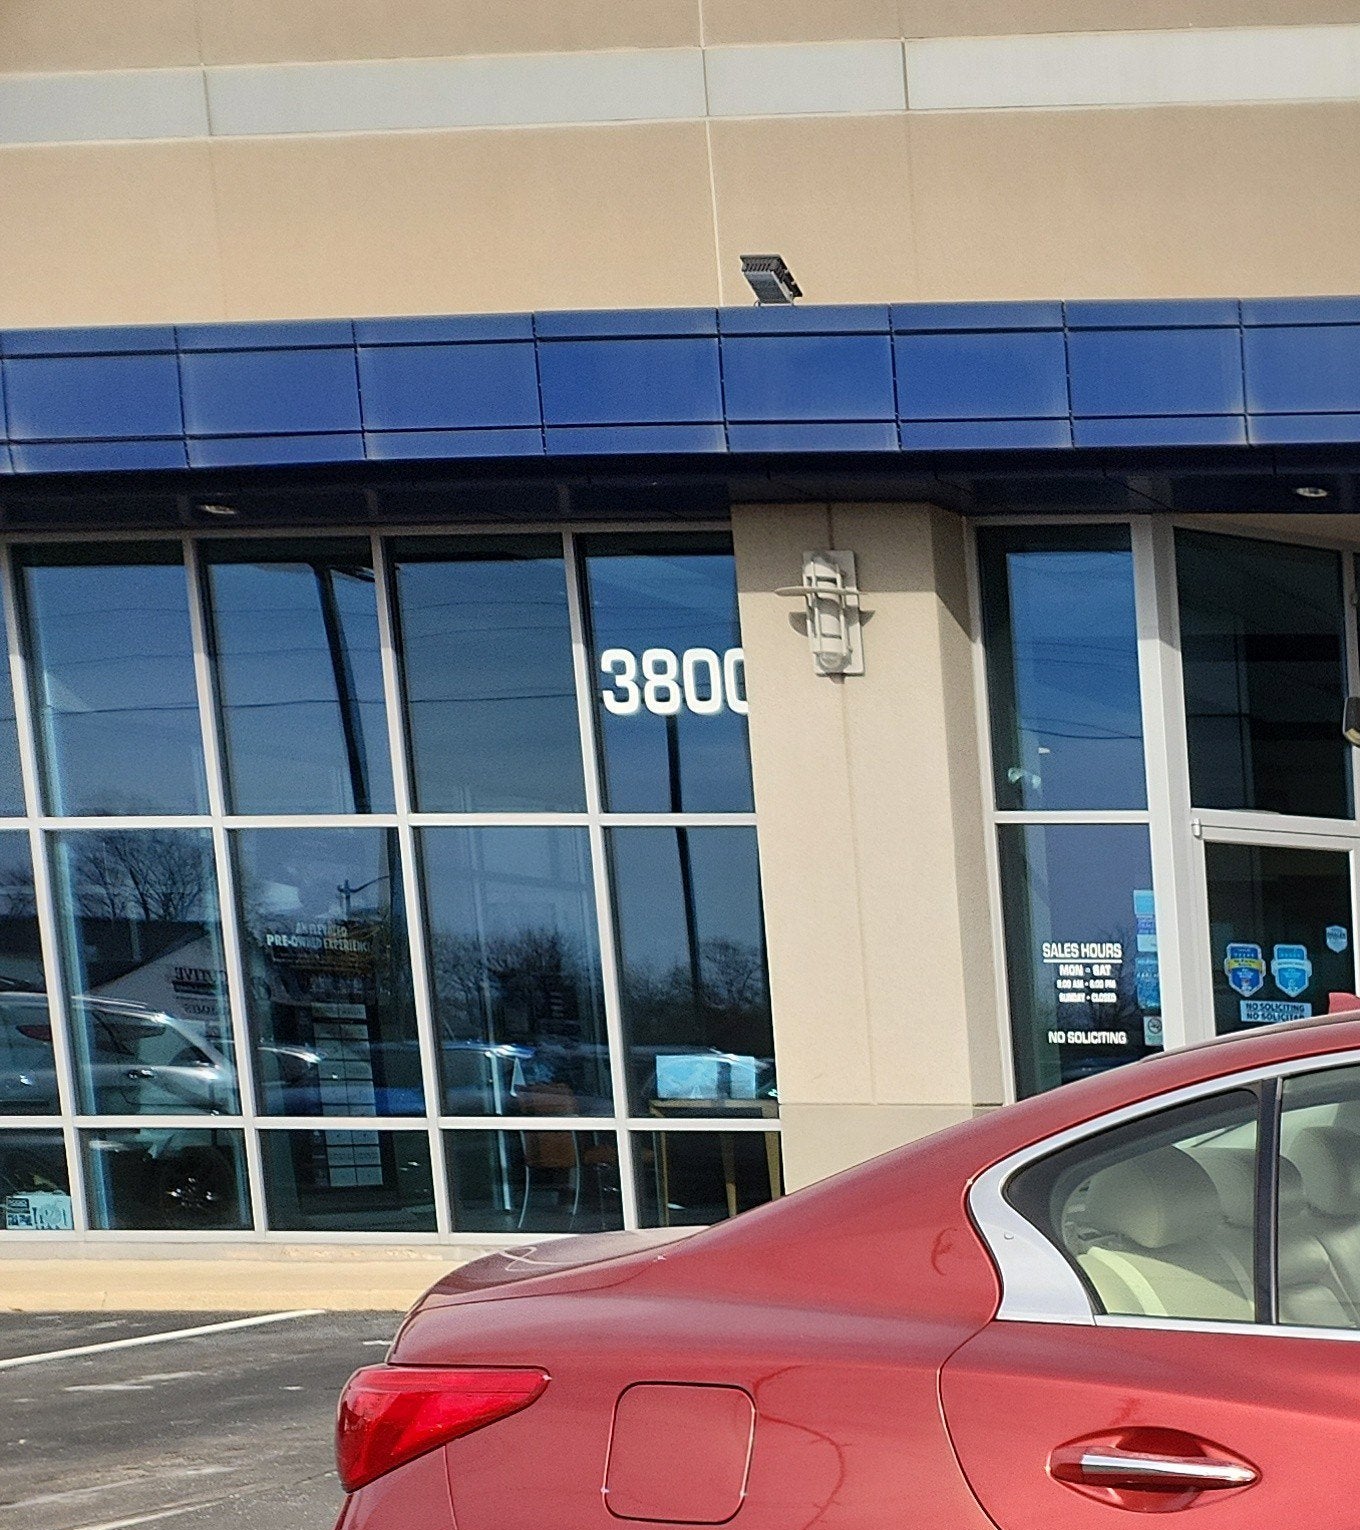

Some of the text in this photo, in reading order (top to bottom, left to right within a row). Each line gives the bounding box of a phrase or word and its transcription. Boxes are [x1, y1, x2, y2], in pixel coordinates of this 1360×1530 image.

[601, 647, 749, 716] 3800
[1042, 942, 1123, 958] SALES HOURS
[1059, 964, 1112, 976] MON SAT
[1047, 1030, 1127, 1045] NO SOLICITING
